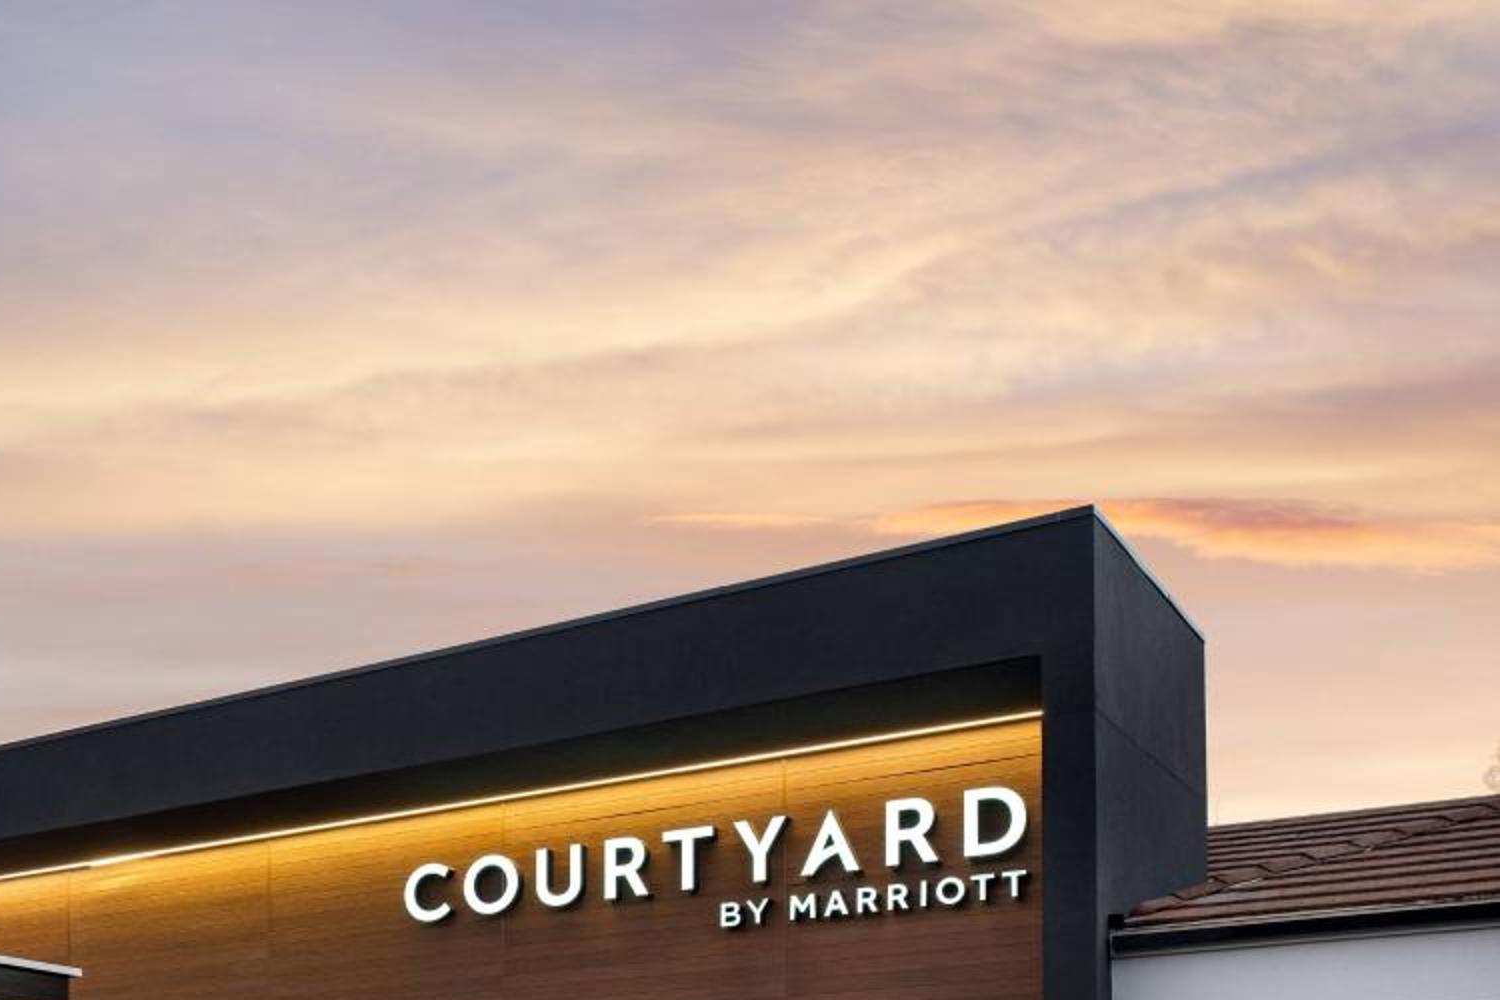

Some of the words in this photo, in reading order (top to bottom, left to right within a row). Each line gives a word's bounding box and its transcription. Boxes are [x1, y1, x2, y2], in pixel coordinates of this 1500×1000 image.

[402, 786, 1028, 923] COURTYARD
[718, 897, 769, 928] BY
[788, 869, 1028, 921] MARRIOTT
